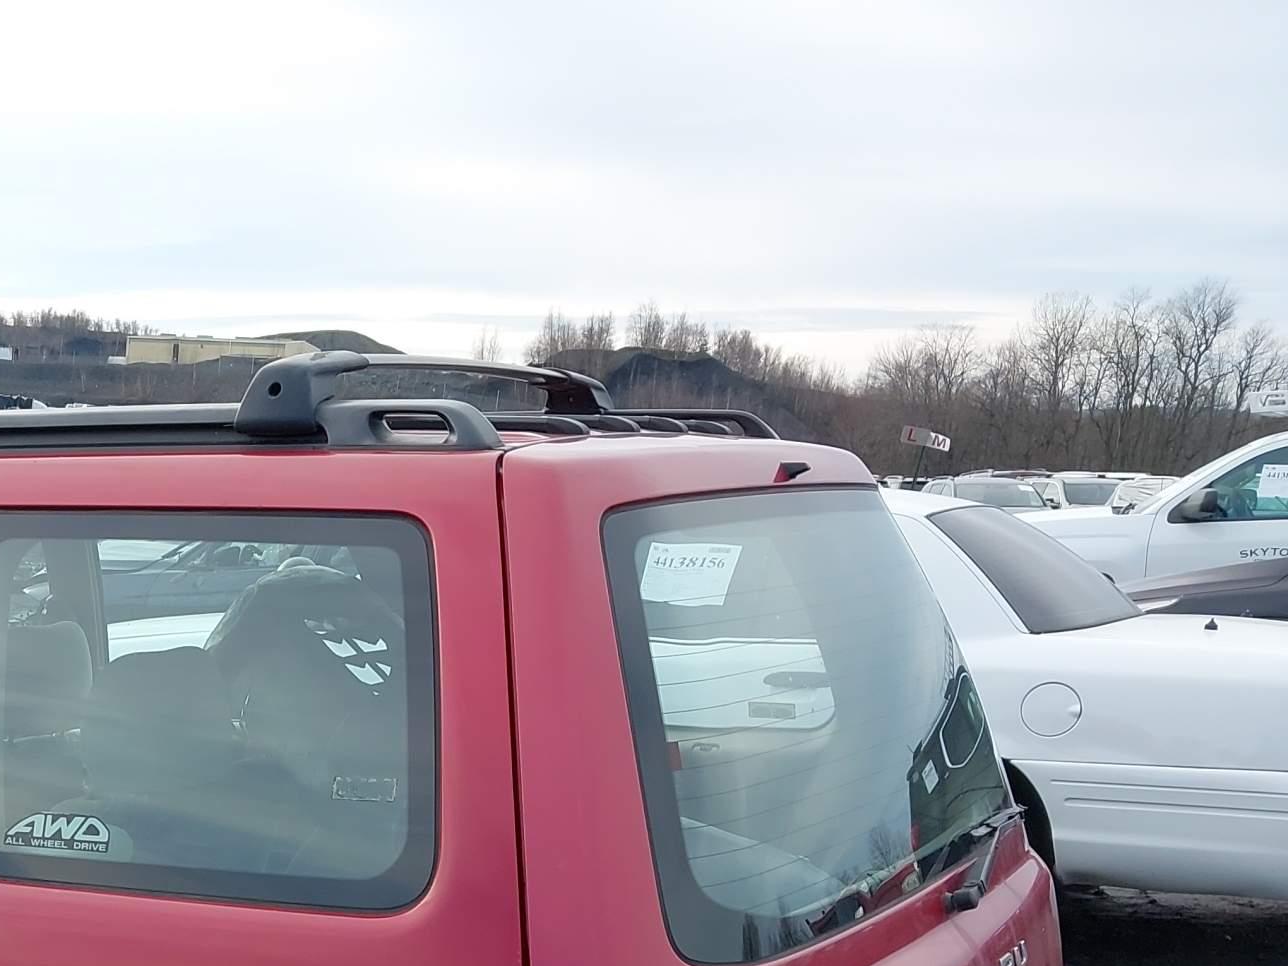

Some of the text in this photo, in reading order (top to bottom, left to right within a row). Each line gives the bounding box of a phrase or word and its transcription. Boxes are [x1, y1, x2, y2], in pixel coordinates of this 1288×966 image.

[906, 428, 917, 442] L
[932, 434, 947, 449] M
[653, 556, 726, 569] 44138156
[6, 813, 110, 843] AWD
[4, 836, 108, 852] ALL WHEEL DRIVE
